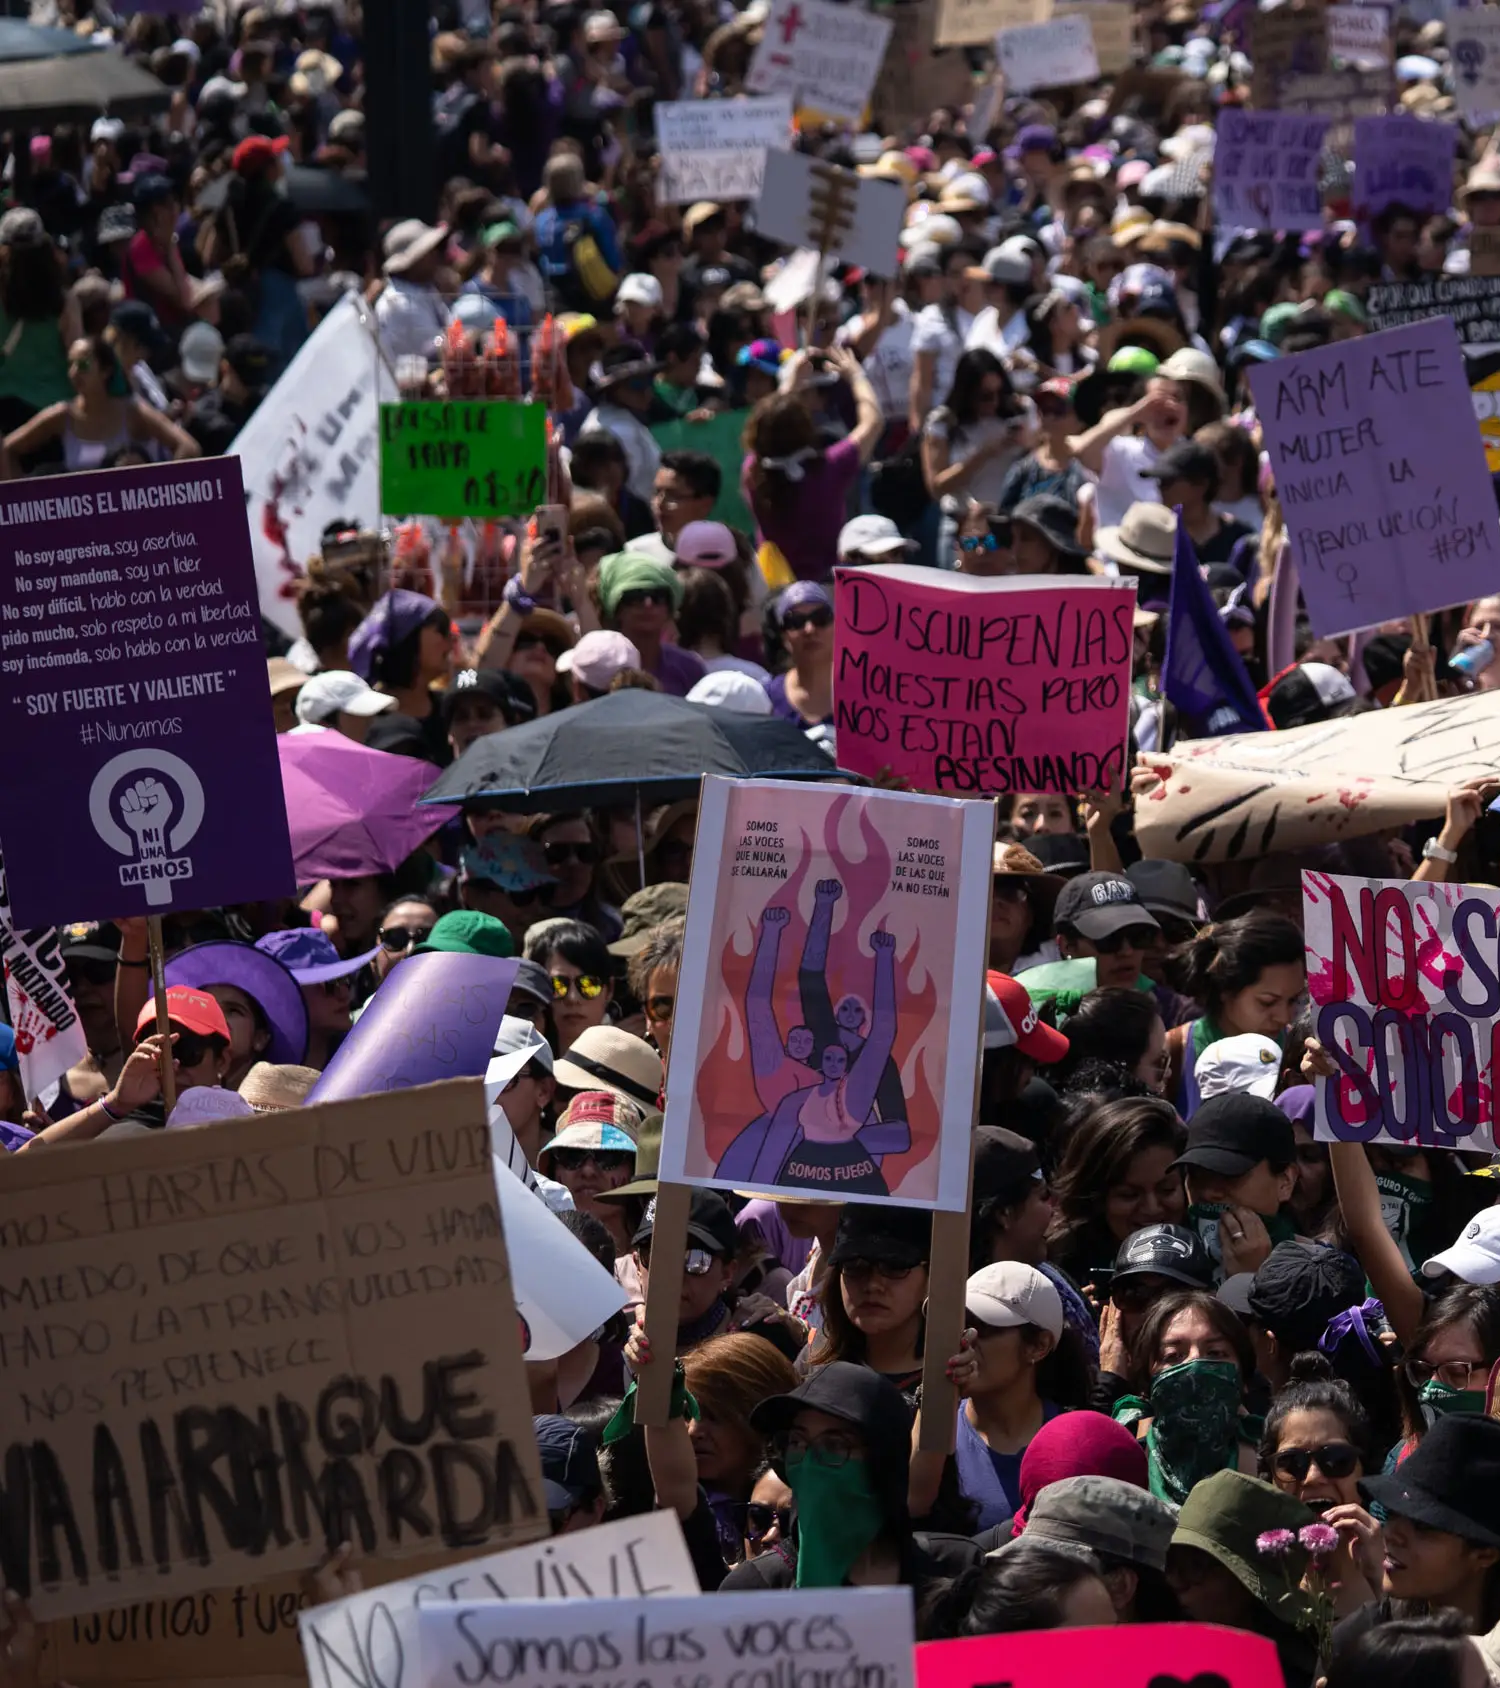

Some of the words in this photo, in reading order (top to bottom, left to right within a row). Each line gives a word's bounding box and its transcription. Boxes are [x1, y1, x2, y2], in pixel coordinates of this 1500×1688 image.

[1279, 418, 1383, 464] MUJER
[97, 492, 118, 514] EL
[121, 479, 213, 511] MACHISMO
[1284, 471, 1353, 505] INICIA
[1389, 459, 1415, 483] LA
[15, 550, 32, 567] No
[34, 550, 54, 568] soy
[57, 540, 115, 565] agresiva,
[115, 538, 138, 556] soy
[1430, 521, 1492, 564] #8M
[15, 576, 32, 593] No
[36, 576, 57, 595] soy
[61, 568, 123, 588] mandona,
[125, 565, 149, 583] soy
[153, 560, 170, 576] un
[2, 604, 20, 621] No
[22, 602, 44, 621] soy
[90, 591, 127, 611] hablo
[130, 589, 156, 606] con
[160, 585, 173, 601] la
[1, 626, 30, 650] pido
[32, 623, 79, 645] mucho,
[80, 618, 107, 638] solo
[111, 611, 163, 635] respeto
[167, 613, 178, 627] a
[182, 609, 197, 624] mi
[1071, 604, 1131, 668] LAS
[2, 656, 24, 675] soy
[27, 648, 93, 670] incómoda,
[95, 643, 122, 662] solo
[125, 639, 162, 659] hablo
[165, 636, 190, 653] con
[194, 632, 207, 648] la
[26, 692, 58, 716] SOY
[63, 683, 127, 713] FUERTE
[129, 681, 141, 703] Y
[144, 671, 226, 702] VALIENTE
[839, 647, 1028, 715] MOLESTIAS
[1042, 672, 1120, 715] PERO
[80, 716, 183, 745] #Niunamas
[837, 699, 890, 743] NOS
[897, 713, 1020, 757] ESTAN
[933, 737, 1126, 794] ASESINANDO
[142, 828, 160, 844] NI
[739, 835, 754, 847] LAS
[755, 835, 785, 848] VOCES
[746, 820, 779, 833] SOMOS
[906, 836, 940, 851] SOMOS
[121, 859, 191, 883] MENOS
[140, 846, 166, 861] UNA
[735, 850, 751, 863] QUE
[752, 851, 786, 864] NUNCA
[898, 850, 916, 863] LAS
[917, 853, 945, 867] VOCES
[731, 865, 741, 877] SE
[741, 864, 789, 880] CALLARÁN
[891, 880, 904, 893] YA
[905, 882, 920, 895] NO
[921, 882, 950, 898] ESTÁN
[895, 865, 908, 878] DE
[909, 867, 927, 880] LAS
[928, 869, 946, 883] QUE
[1330, 886, 1419, 1008] NO
[8, 951, 78, 1033] MATANDO
[1315, 1001, 1480, 1146] SOLO
[100, 1152, 289, 1233] HARTAS
[313, 1142, 376, 1197] DE
[788, 1161, 832, 1181] SOMOS
[834, 1160, 874, 1181] FUEGO
[453, 1609, 621, 1686] Somos
[636, 1613, 706, 1667] las
[723, 1611, 854, 1662] voces
